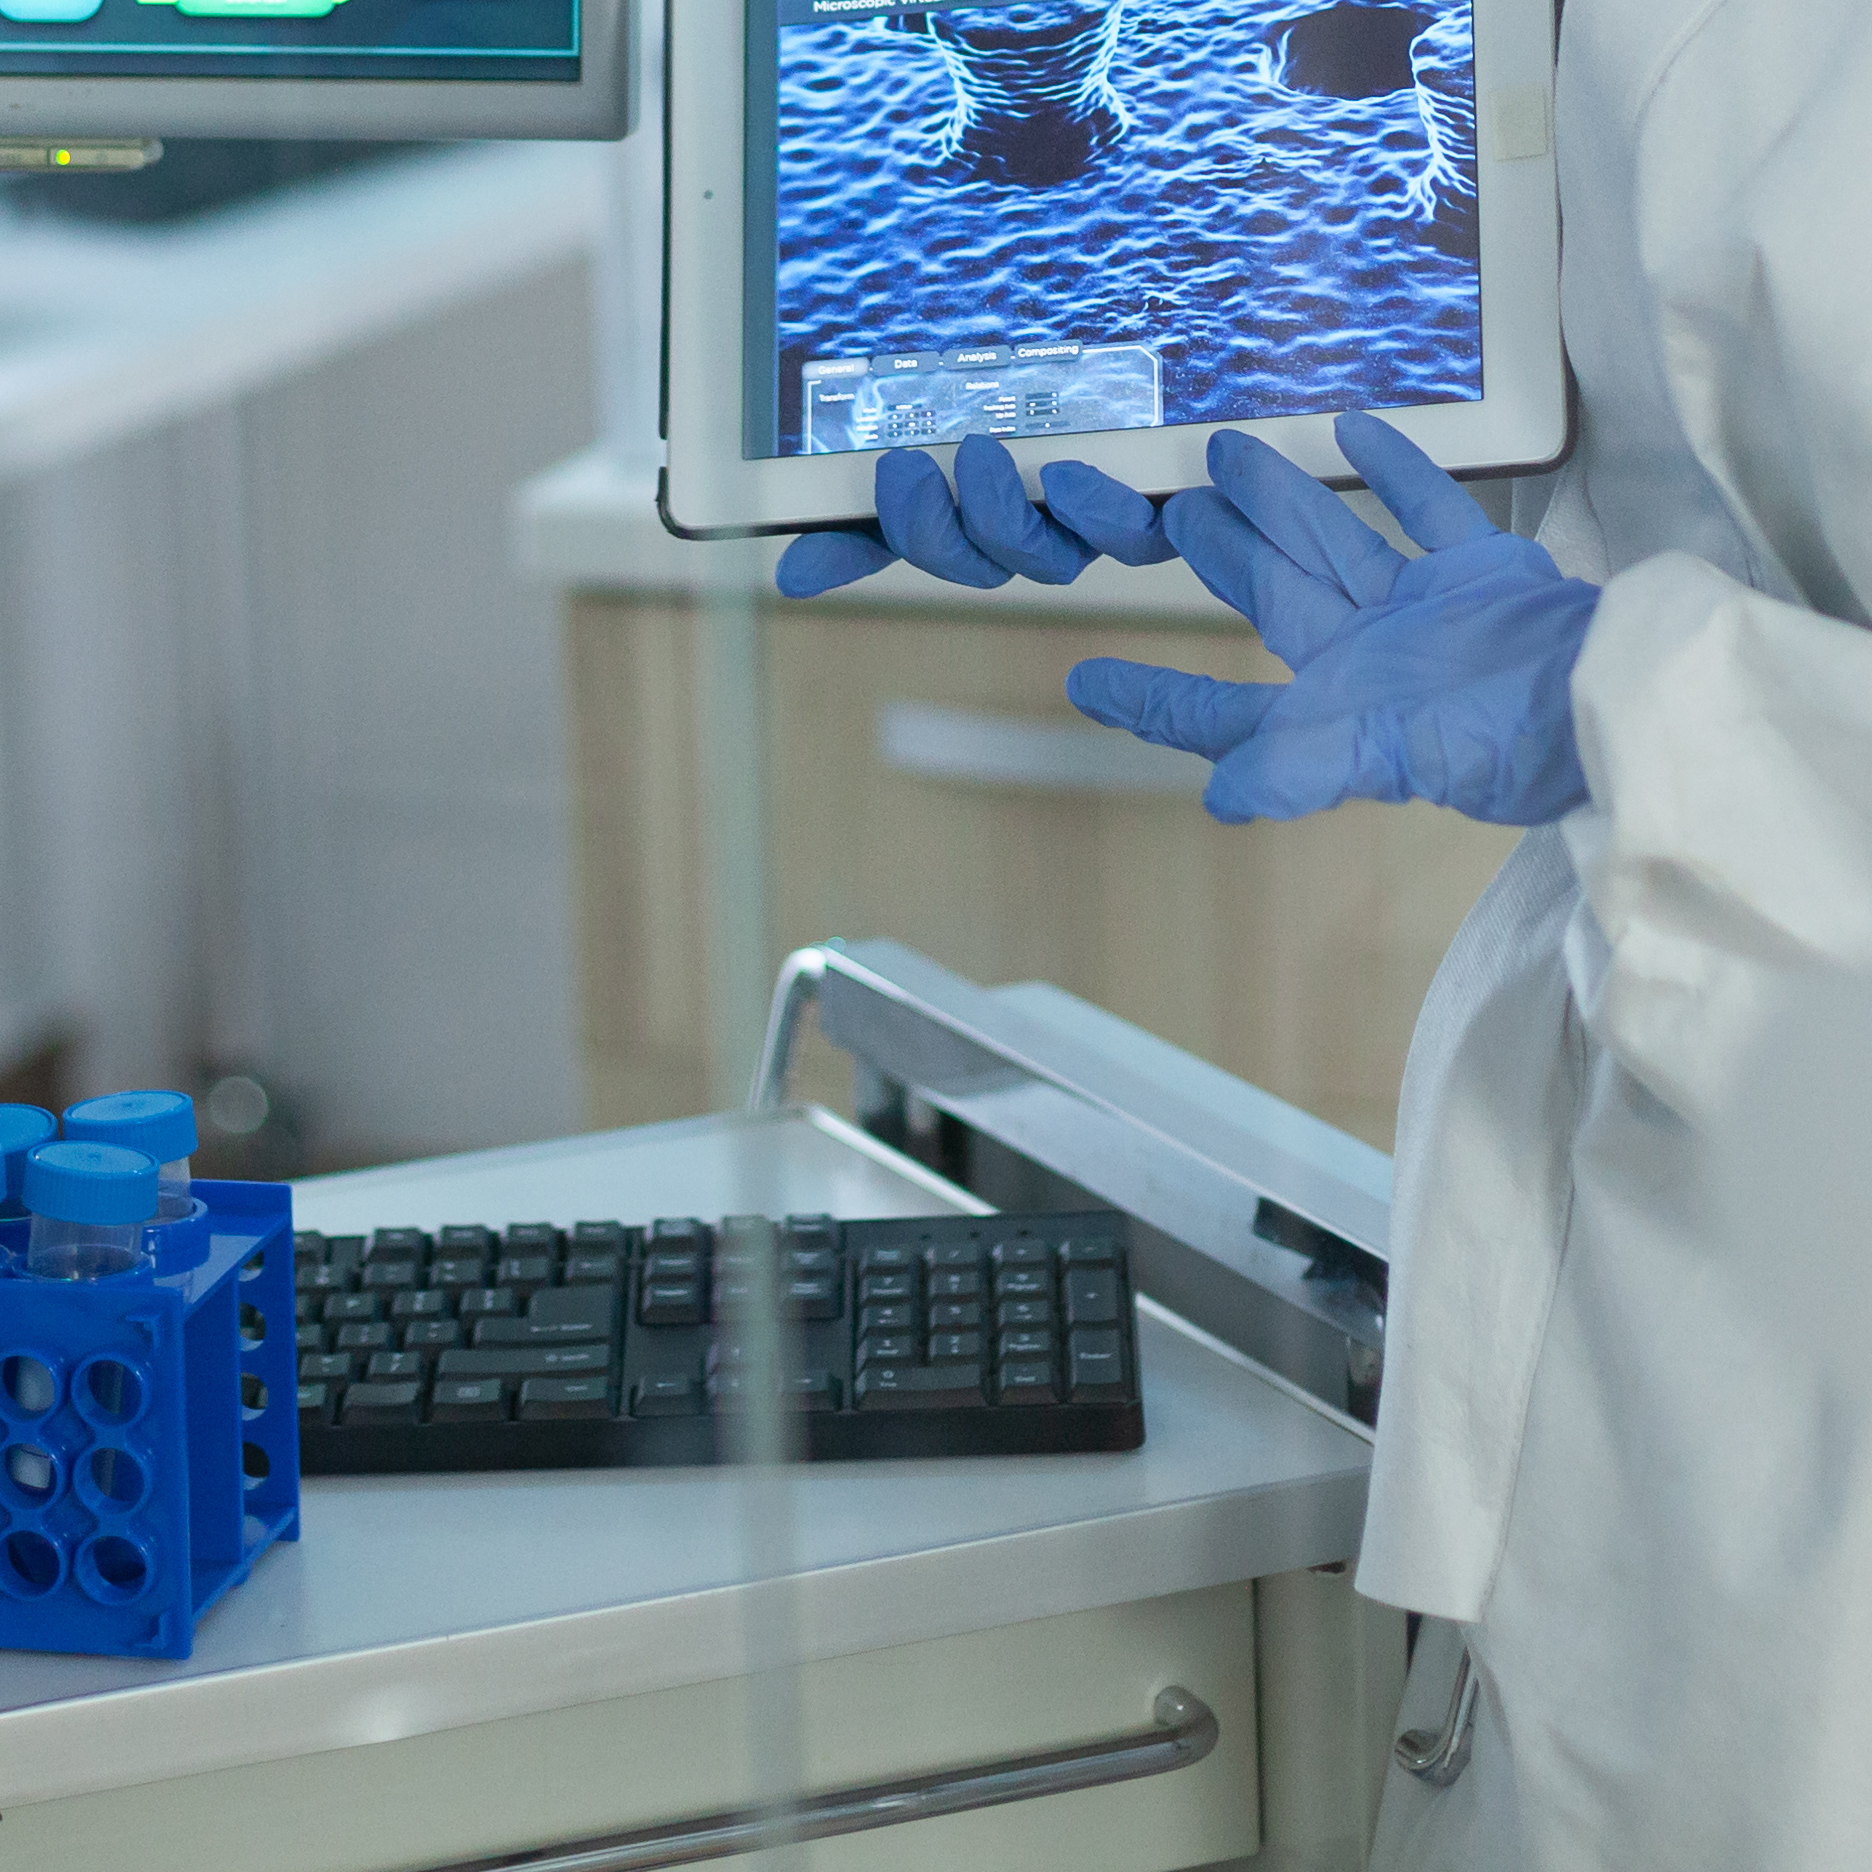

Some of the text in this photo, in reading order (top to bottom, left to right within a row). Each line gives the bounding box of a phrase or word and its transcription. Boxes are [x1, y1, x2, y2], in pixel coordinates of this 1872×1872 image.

[894, 358, 918, 370] Data
[957, 350, 997, 364] Analysis
[1018, 342, 1079, 359] Compositing
